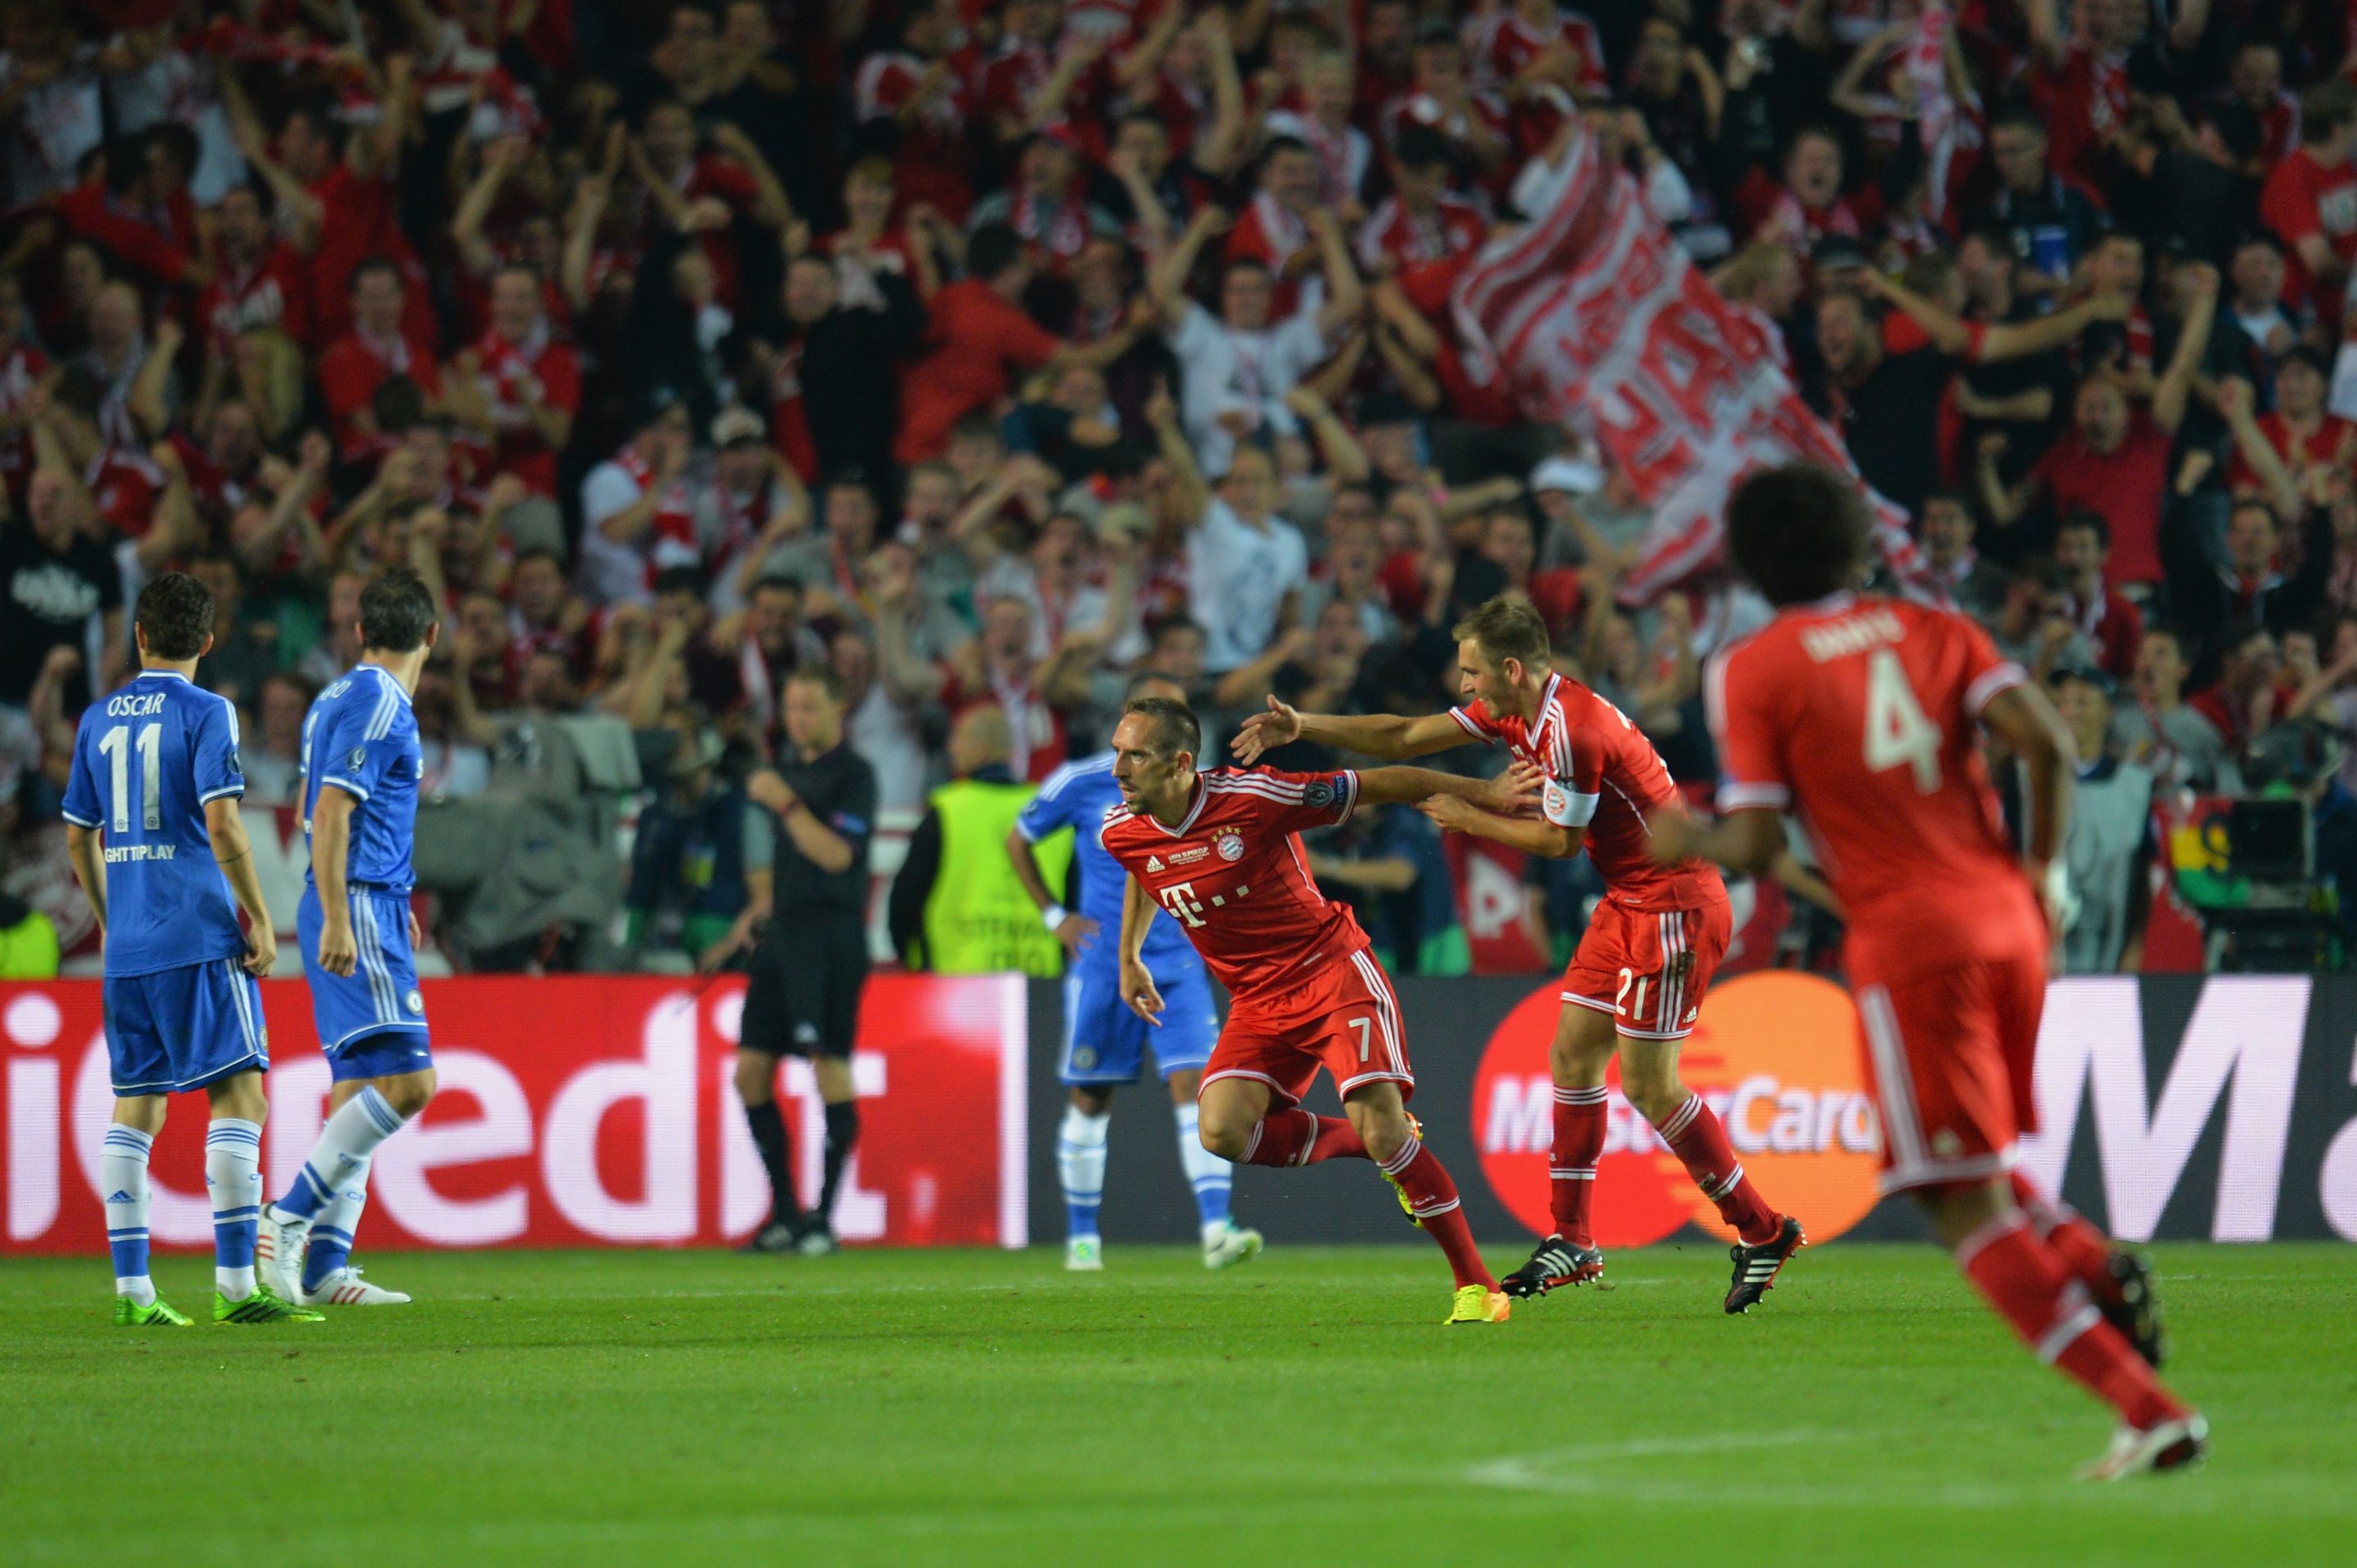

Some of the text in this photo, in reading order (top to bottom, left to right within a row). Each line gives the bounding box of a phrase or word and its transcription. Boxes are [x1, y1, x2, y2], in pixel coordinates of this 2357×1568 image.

[107, 693, 167, 717] OSCAR
[1863, 647, 1944, 795] 4
[99, 724, 162, 832] 11
[1616, 968, 1647, 1020] 21
[1348, 1017, 1371, 1062] 7
